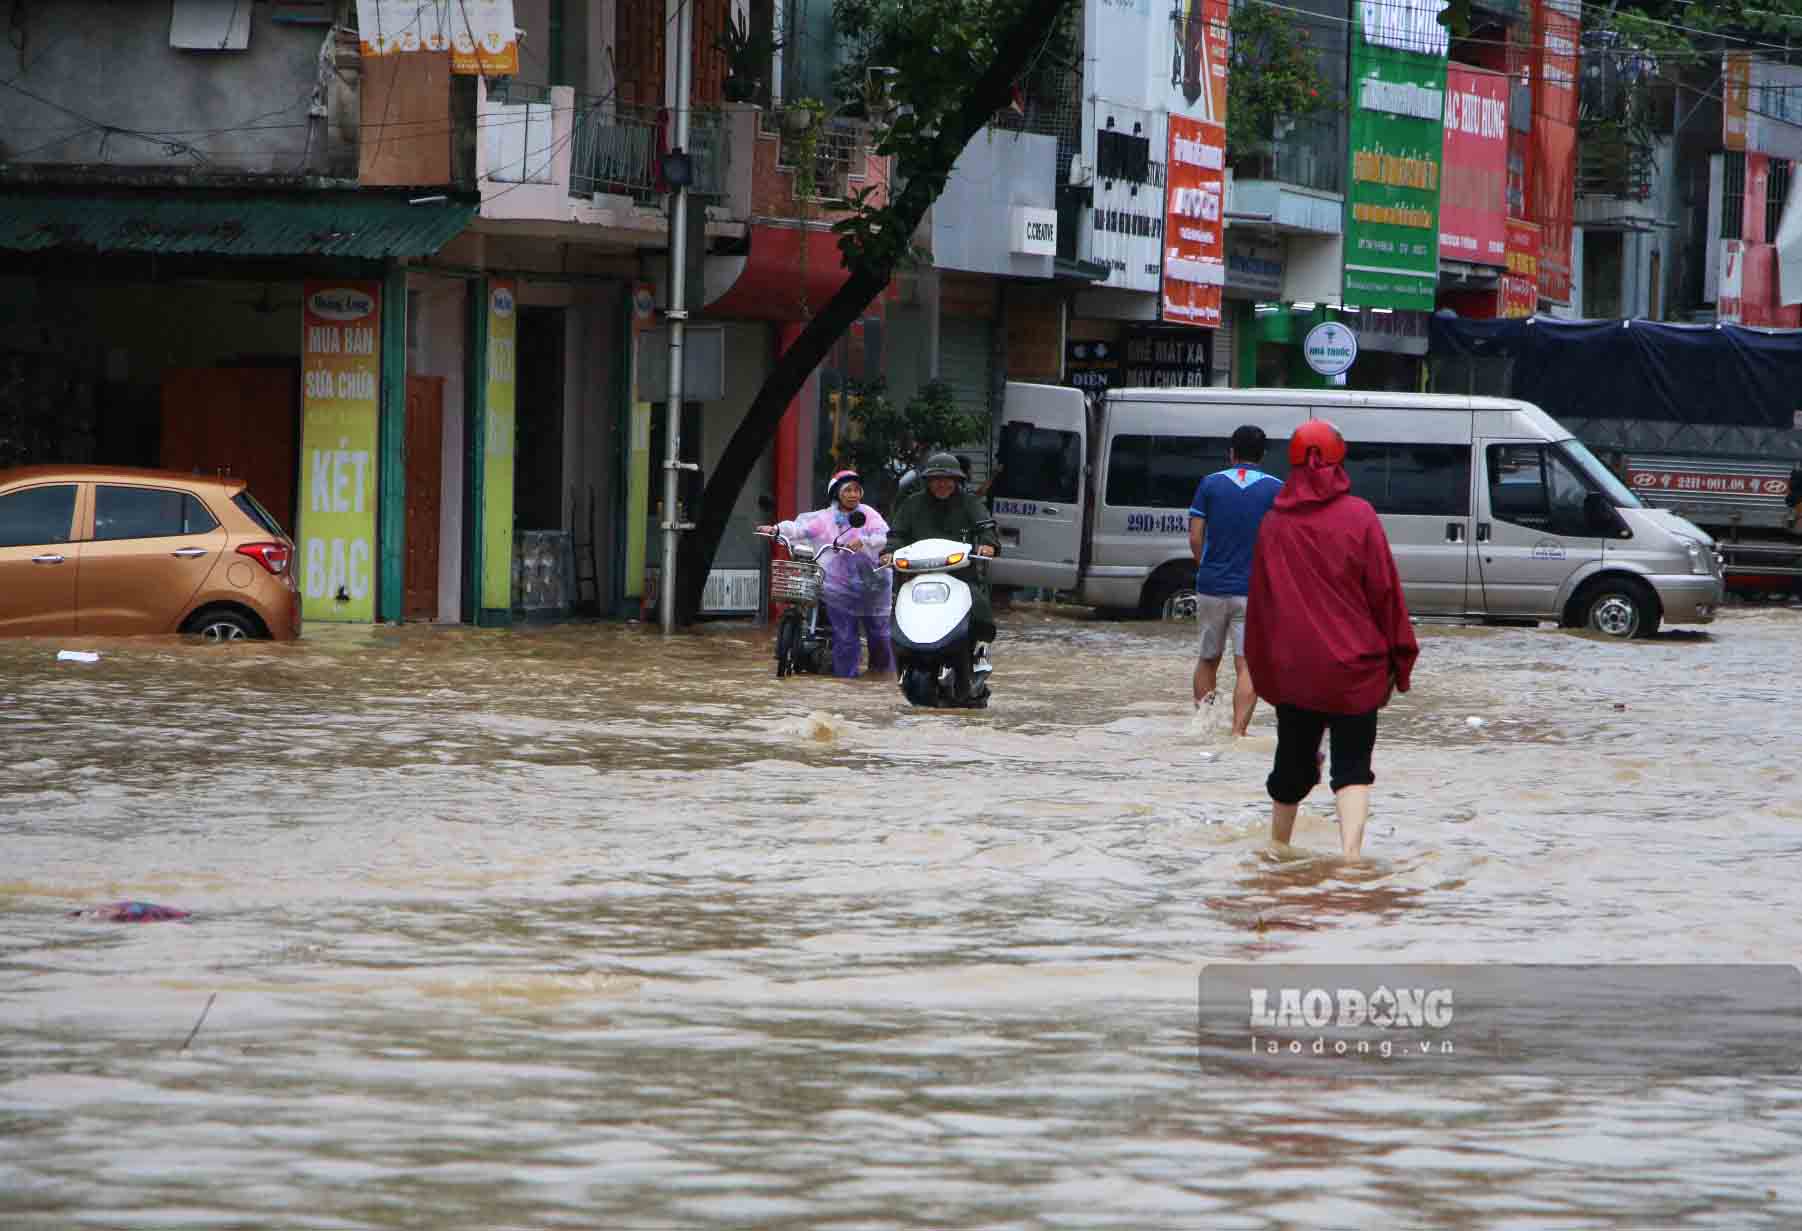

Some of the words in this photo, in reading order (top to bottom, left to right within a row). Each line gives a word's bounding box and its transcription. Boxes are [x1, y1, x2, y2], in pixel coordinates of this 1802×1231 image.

[1444, 87, 1460, 140] ẠC
[1026, 222, 1054, 242] C.CREATIVE
[308, 327, 341, 353] MUA
[344, 321, 374, 353] BÁN
